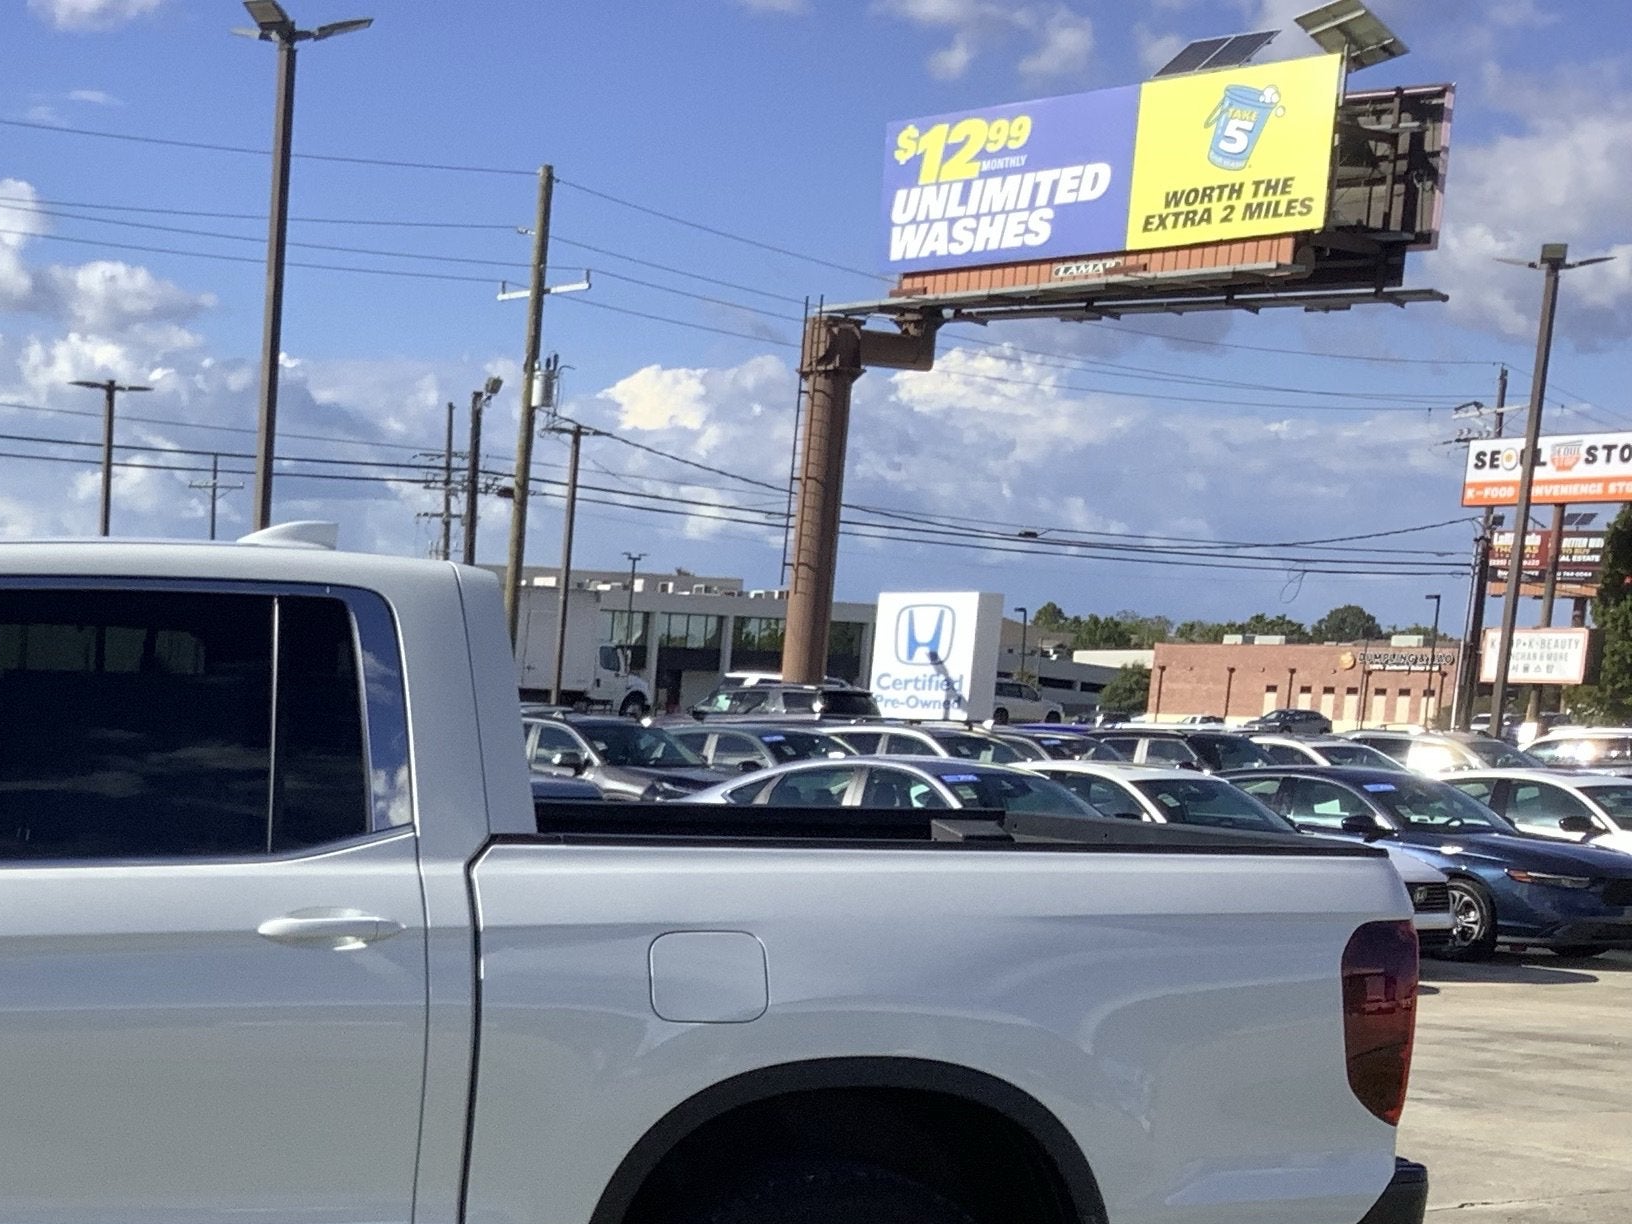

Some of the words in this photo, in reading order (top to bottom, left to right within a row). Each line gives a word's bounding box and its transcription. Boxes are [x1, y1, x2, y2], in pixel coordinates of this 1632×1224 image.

[1228, 109, 1258, 121] TAKE
[1218, 119, 1255, 154] 5
[981, 154, 1028, 172] MONTHLY
[891, 162, 1112, 224] UNLIMITED
[1164, 182, 1245, 209] WORTH
[1251, 176, 1296, 199] THE
[1142, 207, 1213, 233] EXTRA
[1219, 204, 1236, 224] 2
[1241, 197, 1314, 221] MILES
[889, 208, 1055, 262] WASHES
[876, 672, 963, 692] Certified
[875, 694, 961, 709] Pre-Owned
